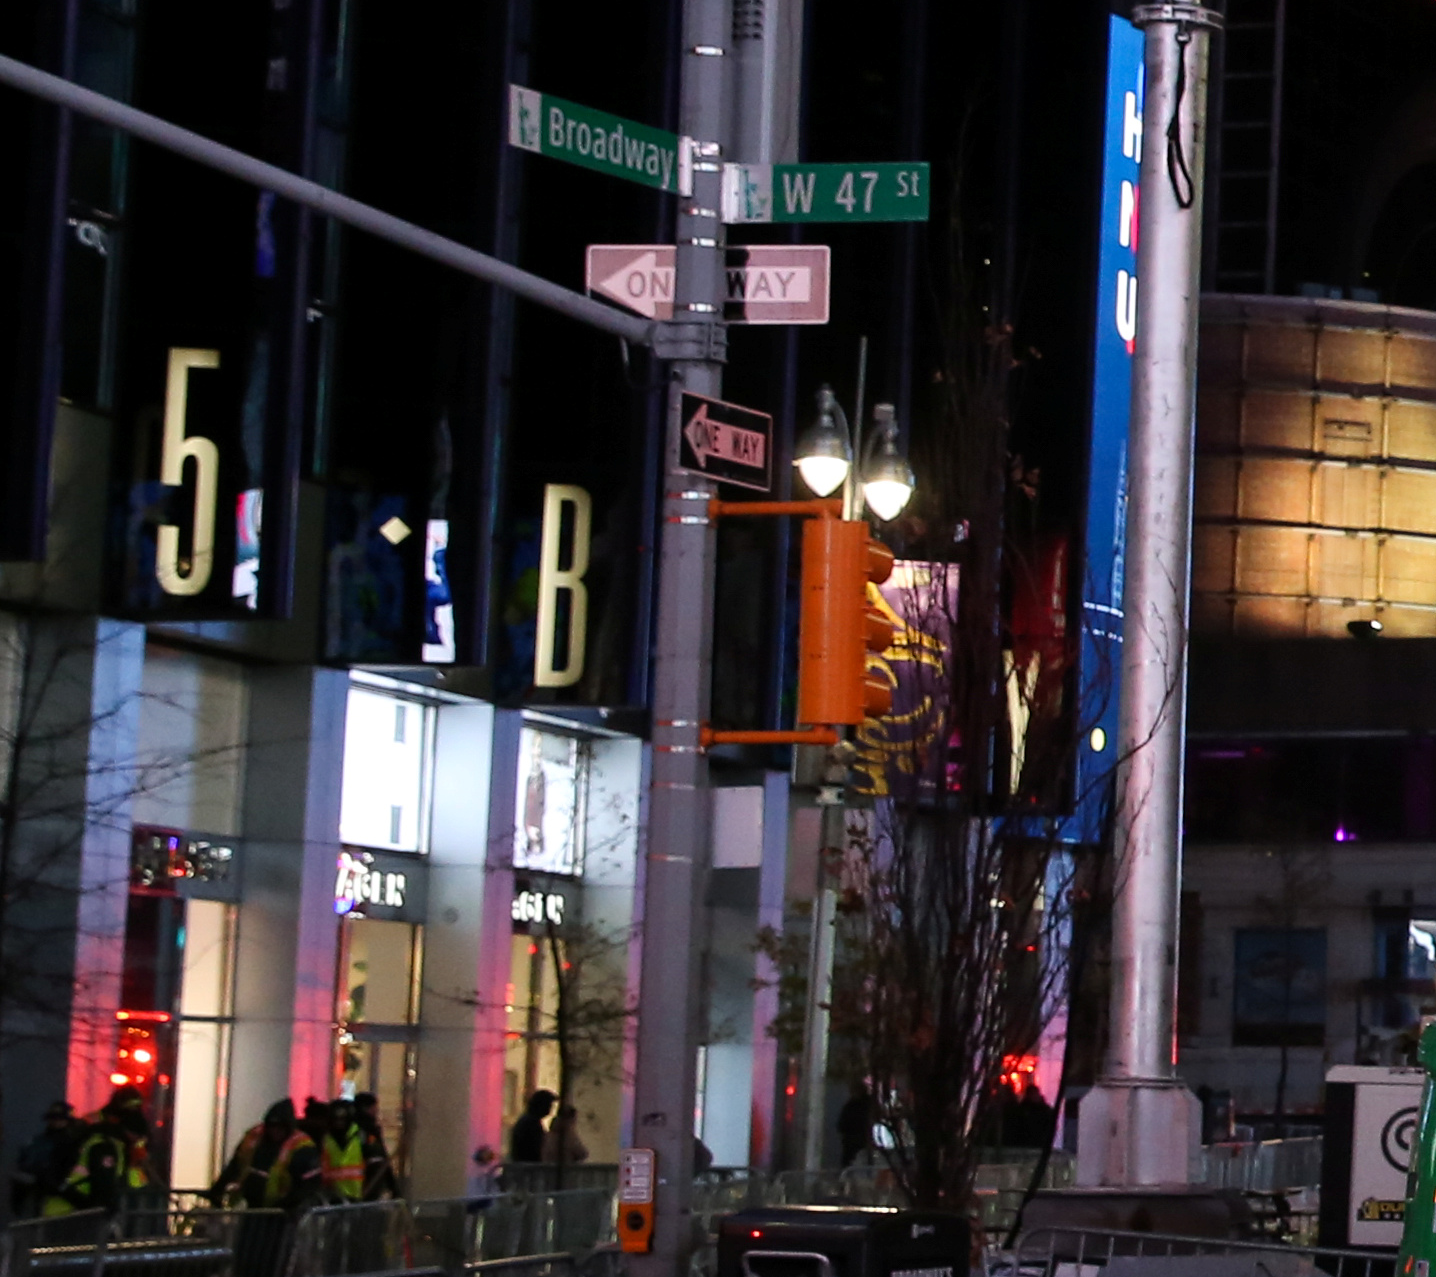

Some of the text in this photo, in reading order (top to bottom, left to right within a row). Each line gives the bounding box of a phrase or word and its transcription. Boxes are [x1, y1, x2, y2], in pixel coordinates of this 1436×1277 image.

[548, 106, 676, 190] Broadway
[783, 170, 920, 214] W 47 St
[627, 271, 796, 298] ON WAY
[732, 432, 760, 459] WAY
[155, 347, 592, 687] 5 B
